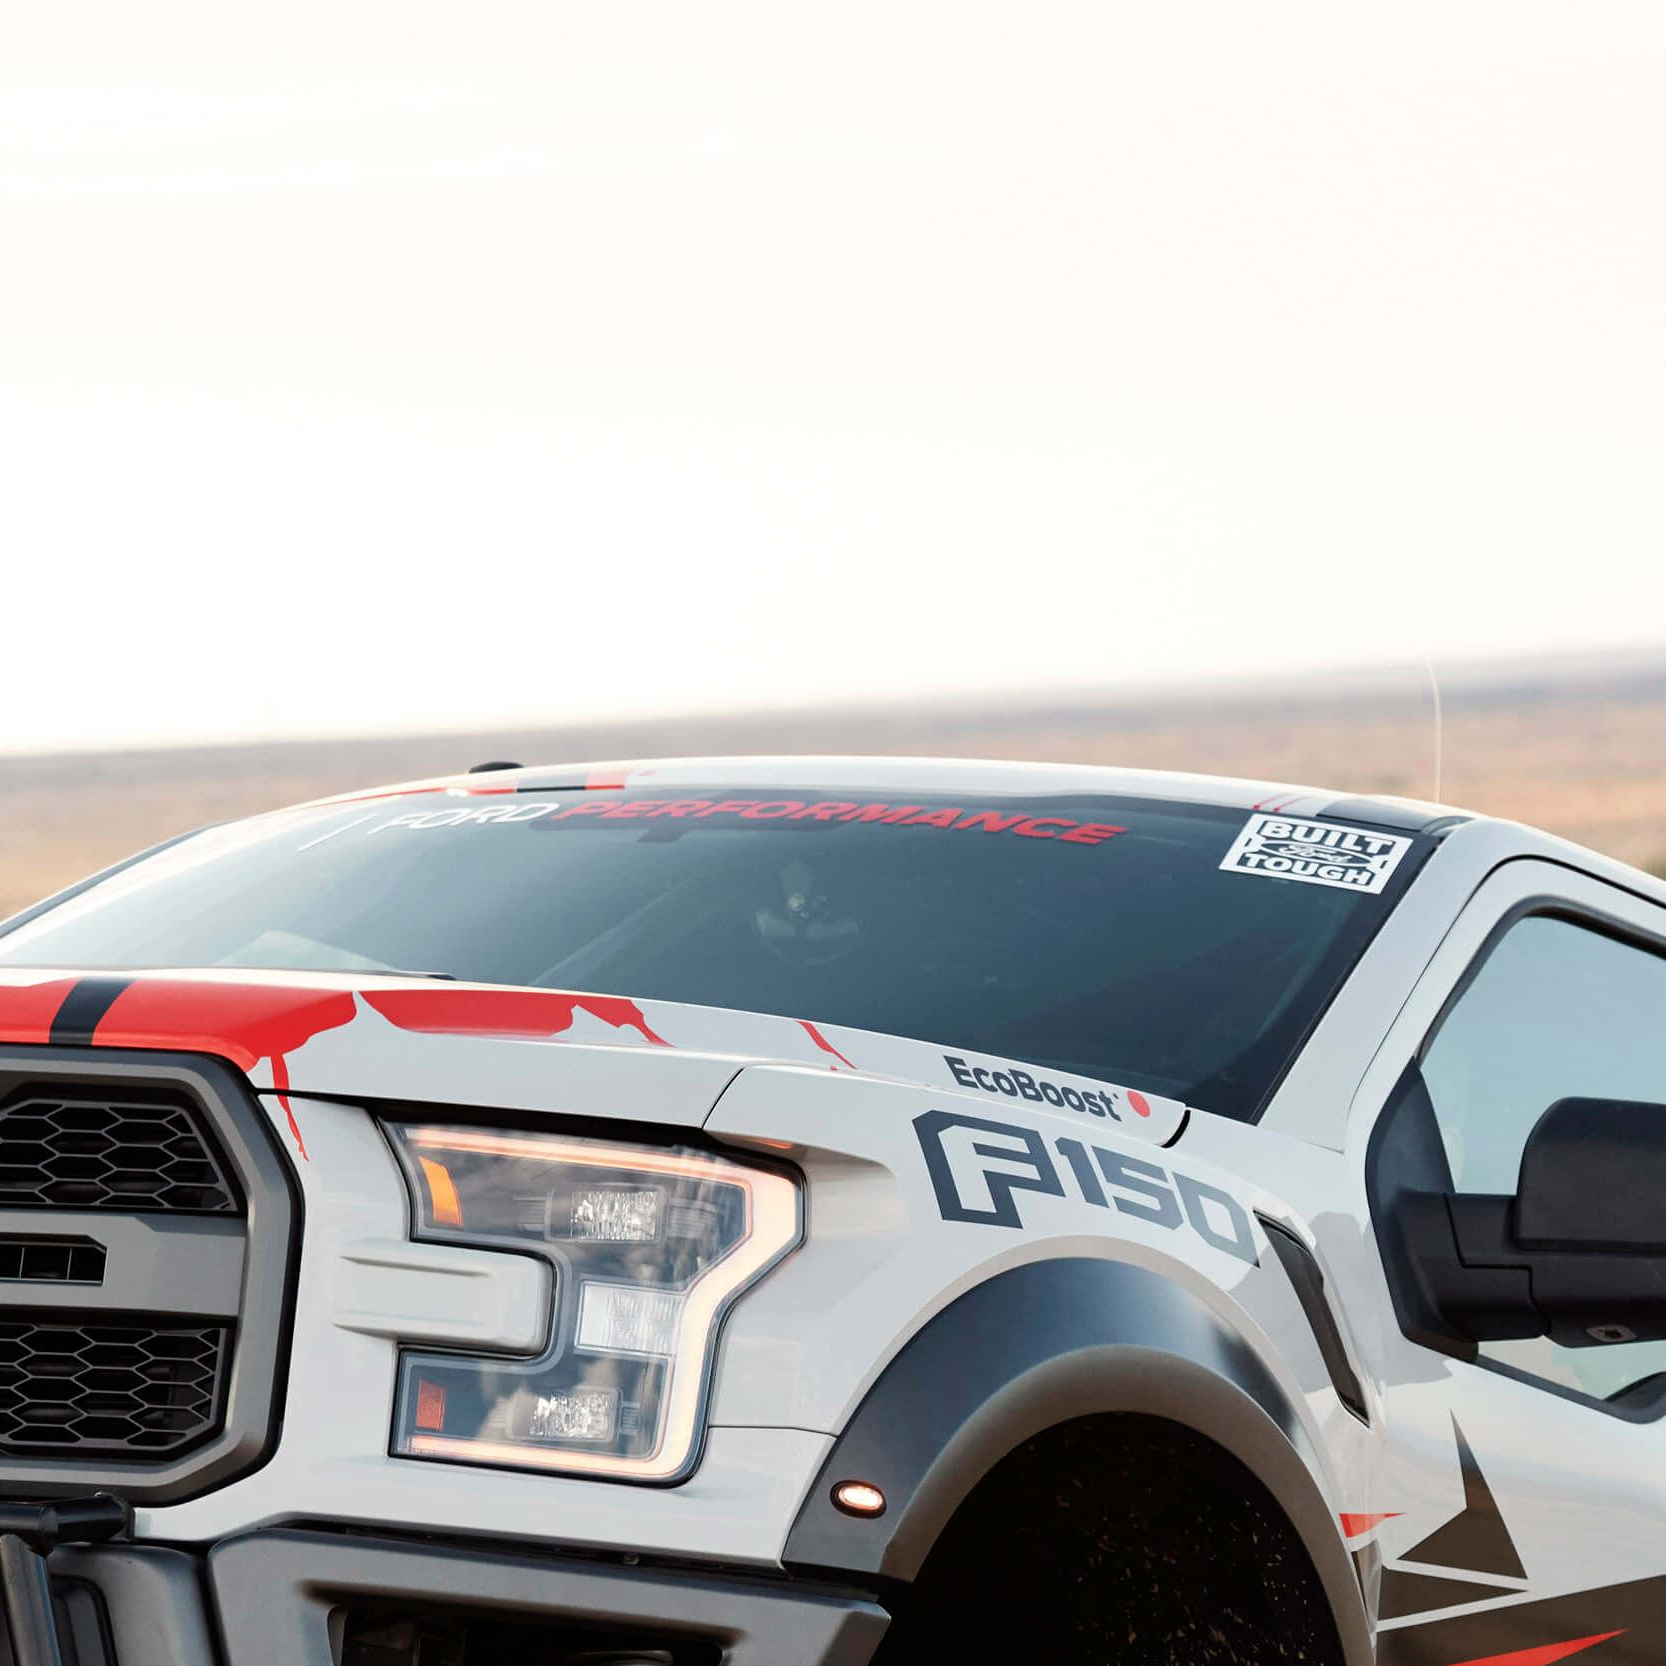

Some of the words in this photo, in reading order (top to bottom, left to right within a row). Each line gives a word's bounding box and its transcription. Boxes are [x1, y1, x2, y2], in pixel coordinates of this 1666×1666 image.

[367, 802, 561, 834] FORD
[550, 799, 1129, 846] PERFORMANCE
[1259, 820, 1394, 855] BUILT
[1244, 853, 1374, 886] TOUGH
[942, 1055, 1121, 1122] EcoBoost
